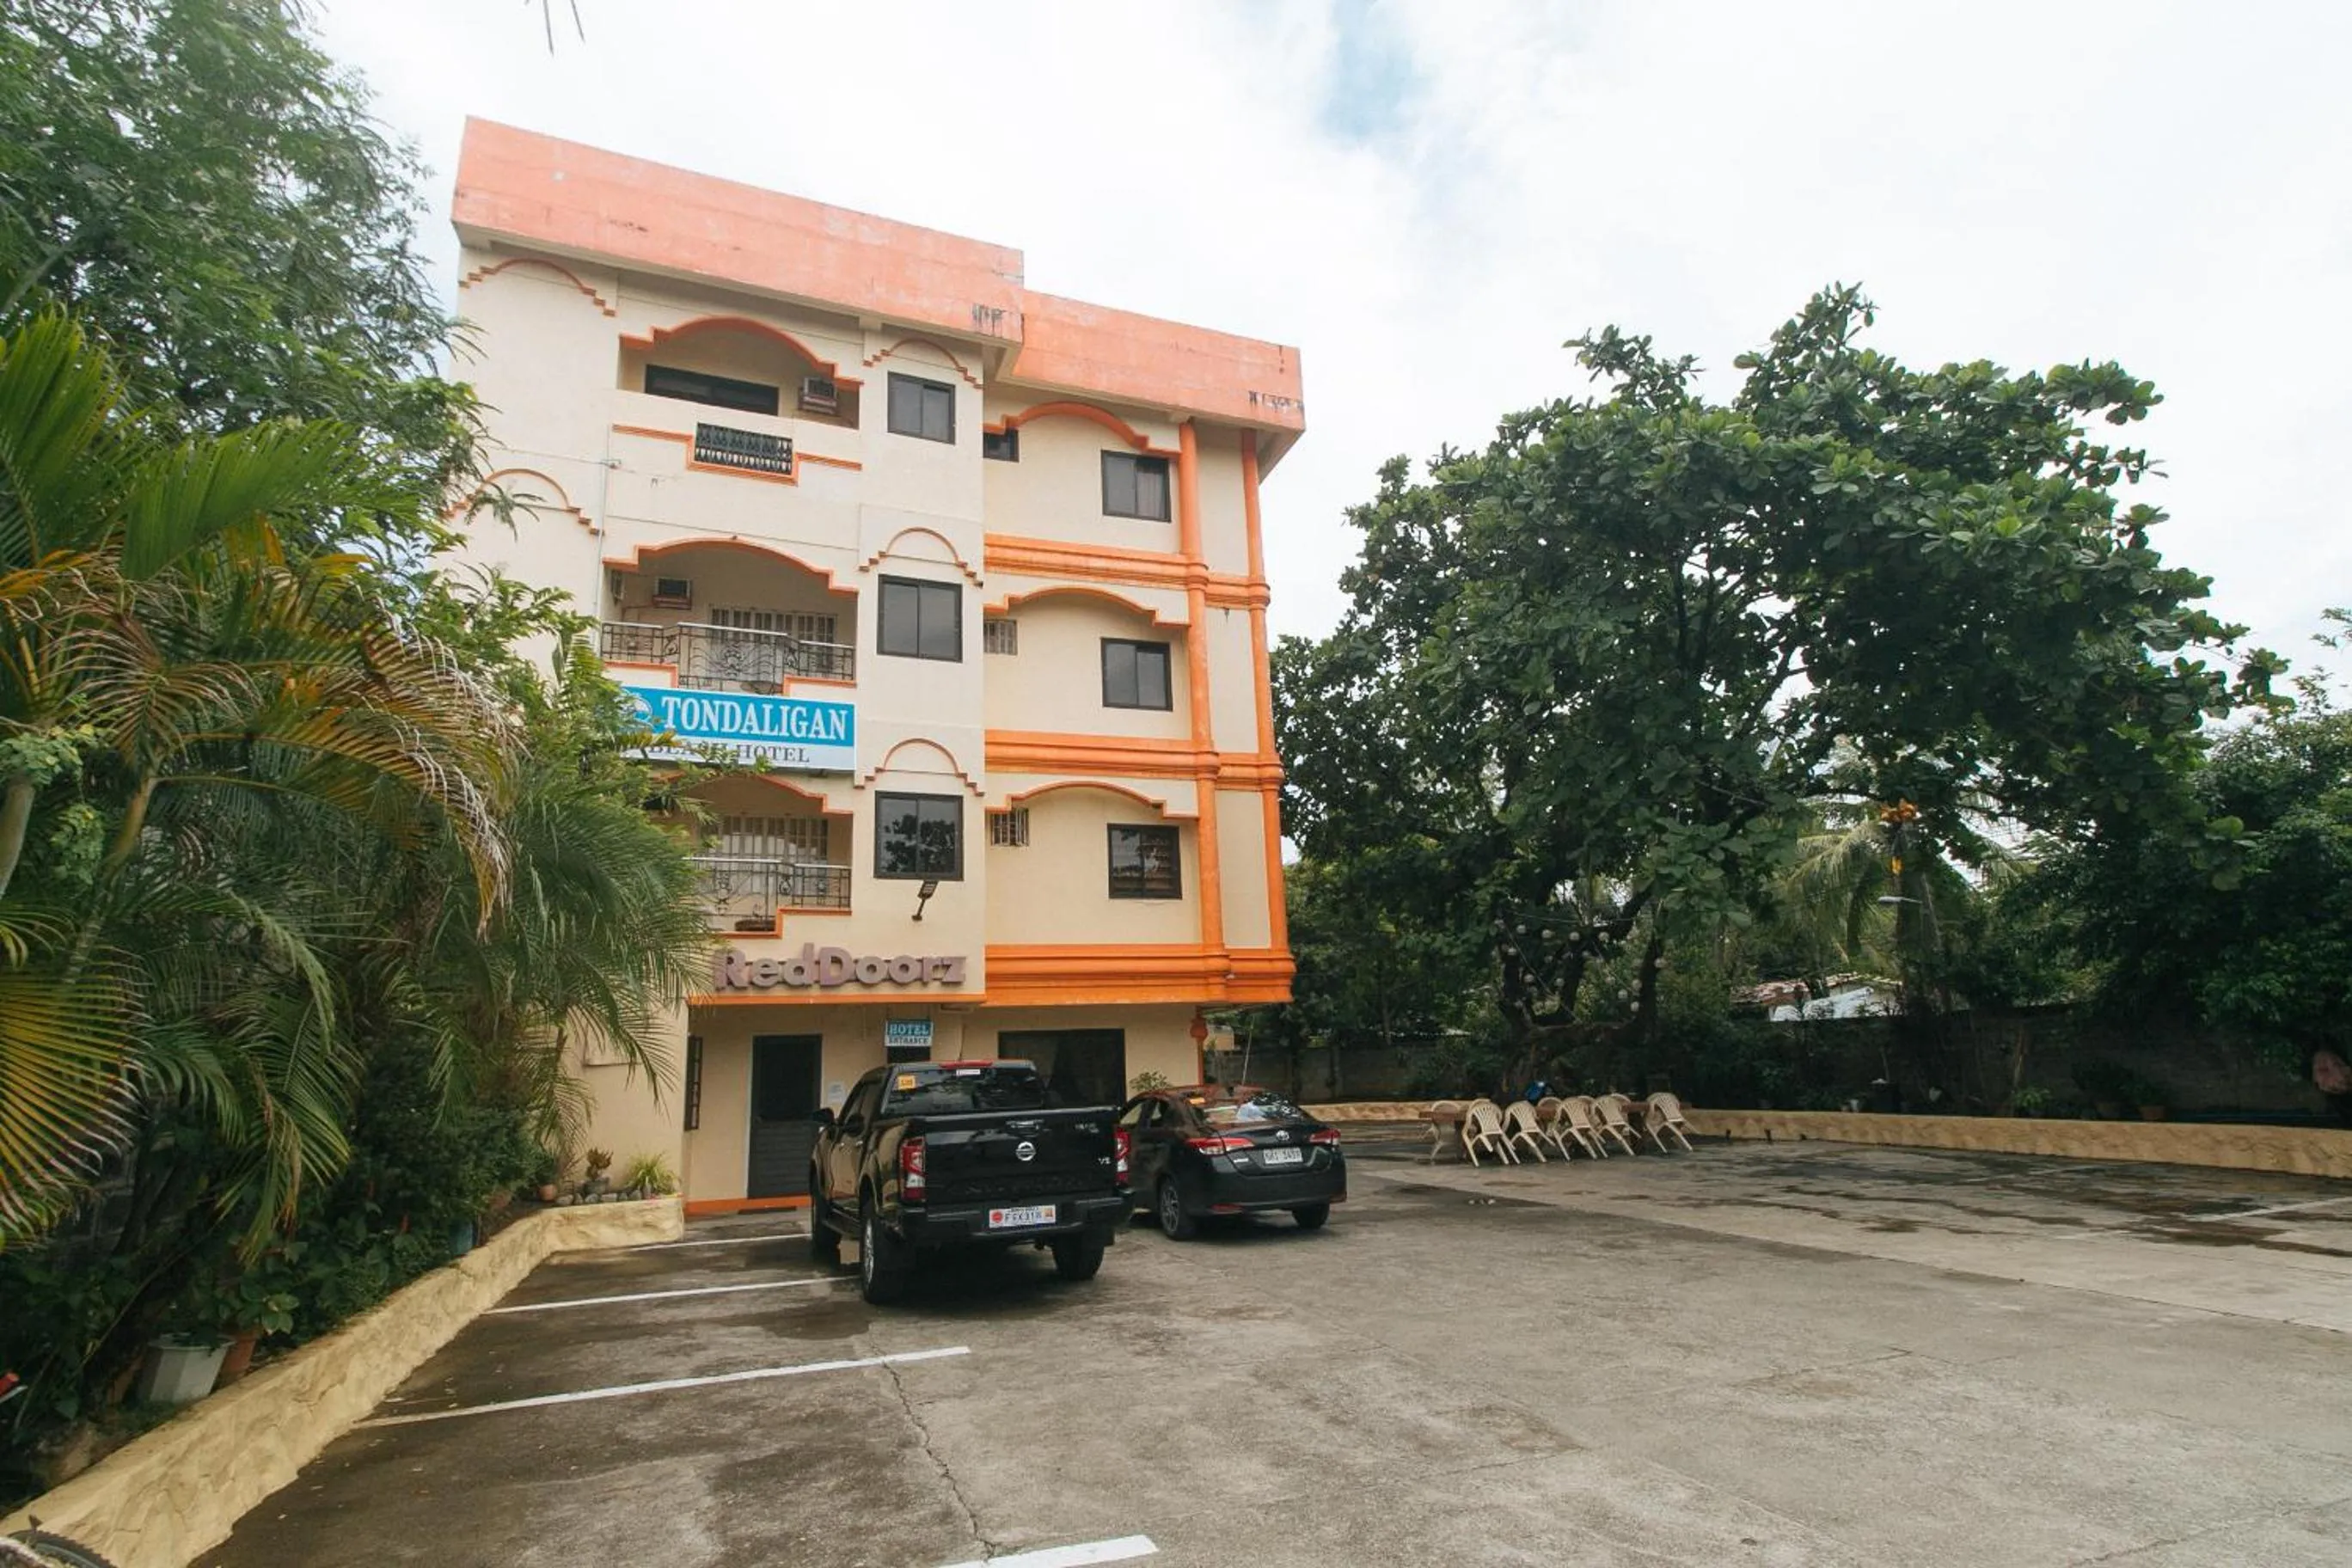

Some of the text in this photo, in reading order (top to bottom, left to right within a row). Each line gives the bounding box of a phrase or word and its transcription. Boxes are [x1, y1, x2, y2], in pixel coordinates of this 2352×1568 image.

[660, 695, 848, 740] TONDALIGAN
[737, 743, 810, 763] HOTEL
[714, 942, 967, 989] RedDoorz
[889, 1023, 929, 1035] HOTEL
